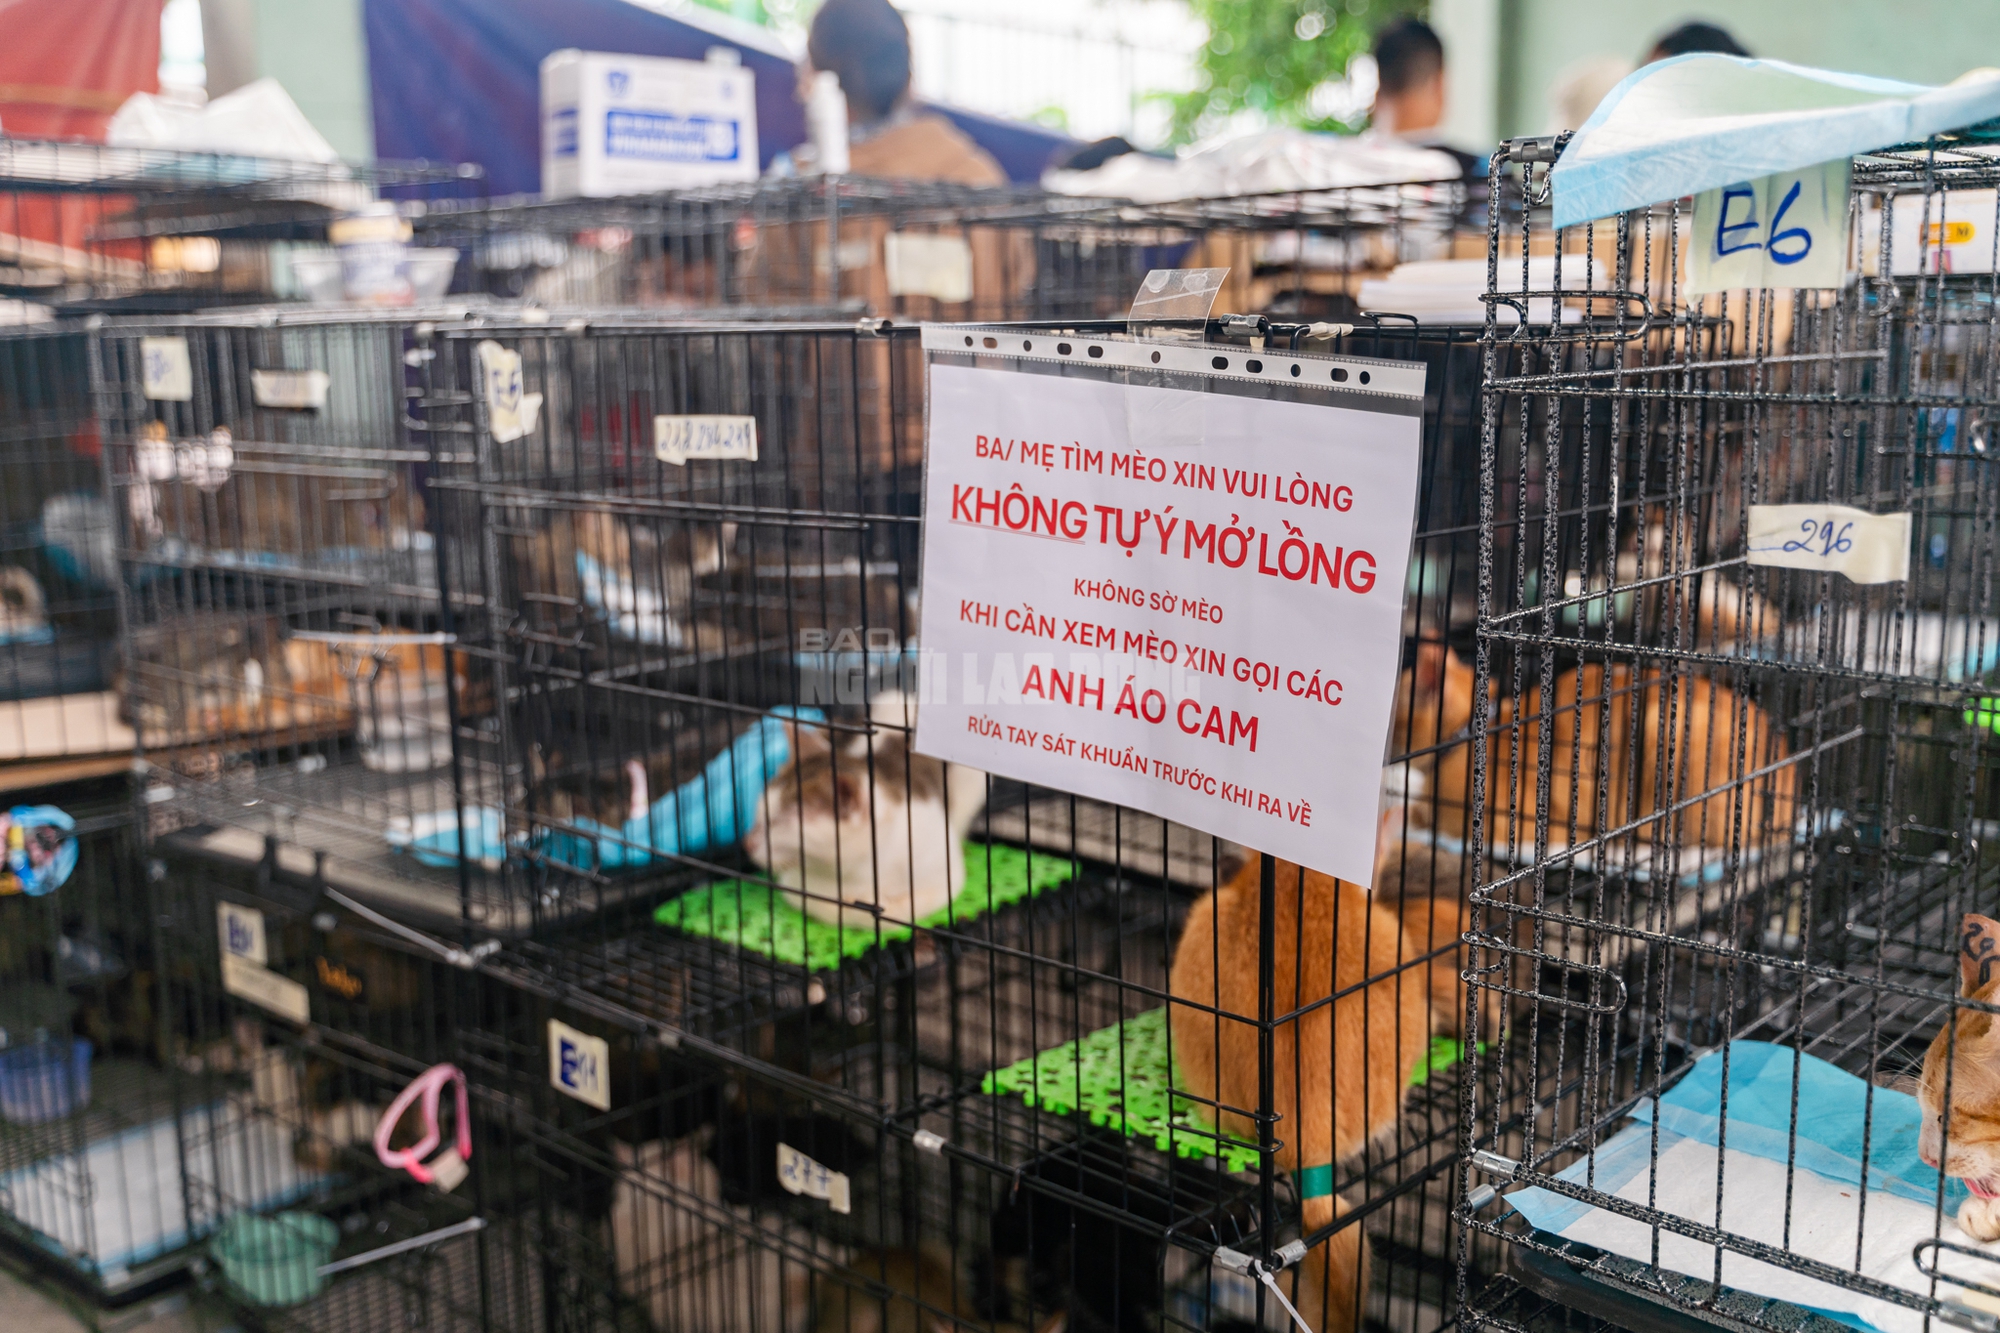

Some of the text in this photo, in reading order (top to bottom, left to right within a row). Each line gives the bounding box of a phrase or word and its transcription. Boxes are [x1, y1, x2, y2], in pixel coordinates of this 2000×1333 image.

[1716, 180, 1811, 265] E6
[976, 435, 1352, 512] BA/ MẸ TÌM MÈO XIN VUI LÒNG
[952, 482, 1376, 594] KHÔNG TỰ Ý MỞ LỒNG
[1783, 519, 1853, 556] 296
[1074, 578, 1223, 624] KHÔNG SỜ MÈO
[960, 600, 1343, 706] KHI CẦN XEM MÈO XIN GỌI CÁC
[1022, 665, 1258, 752] ANH ÁO CAM
[968, 714, 1311, 827] RỬA TAY SÁT KHUẨN TRƯỚC KHI RA VỀ
